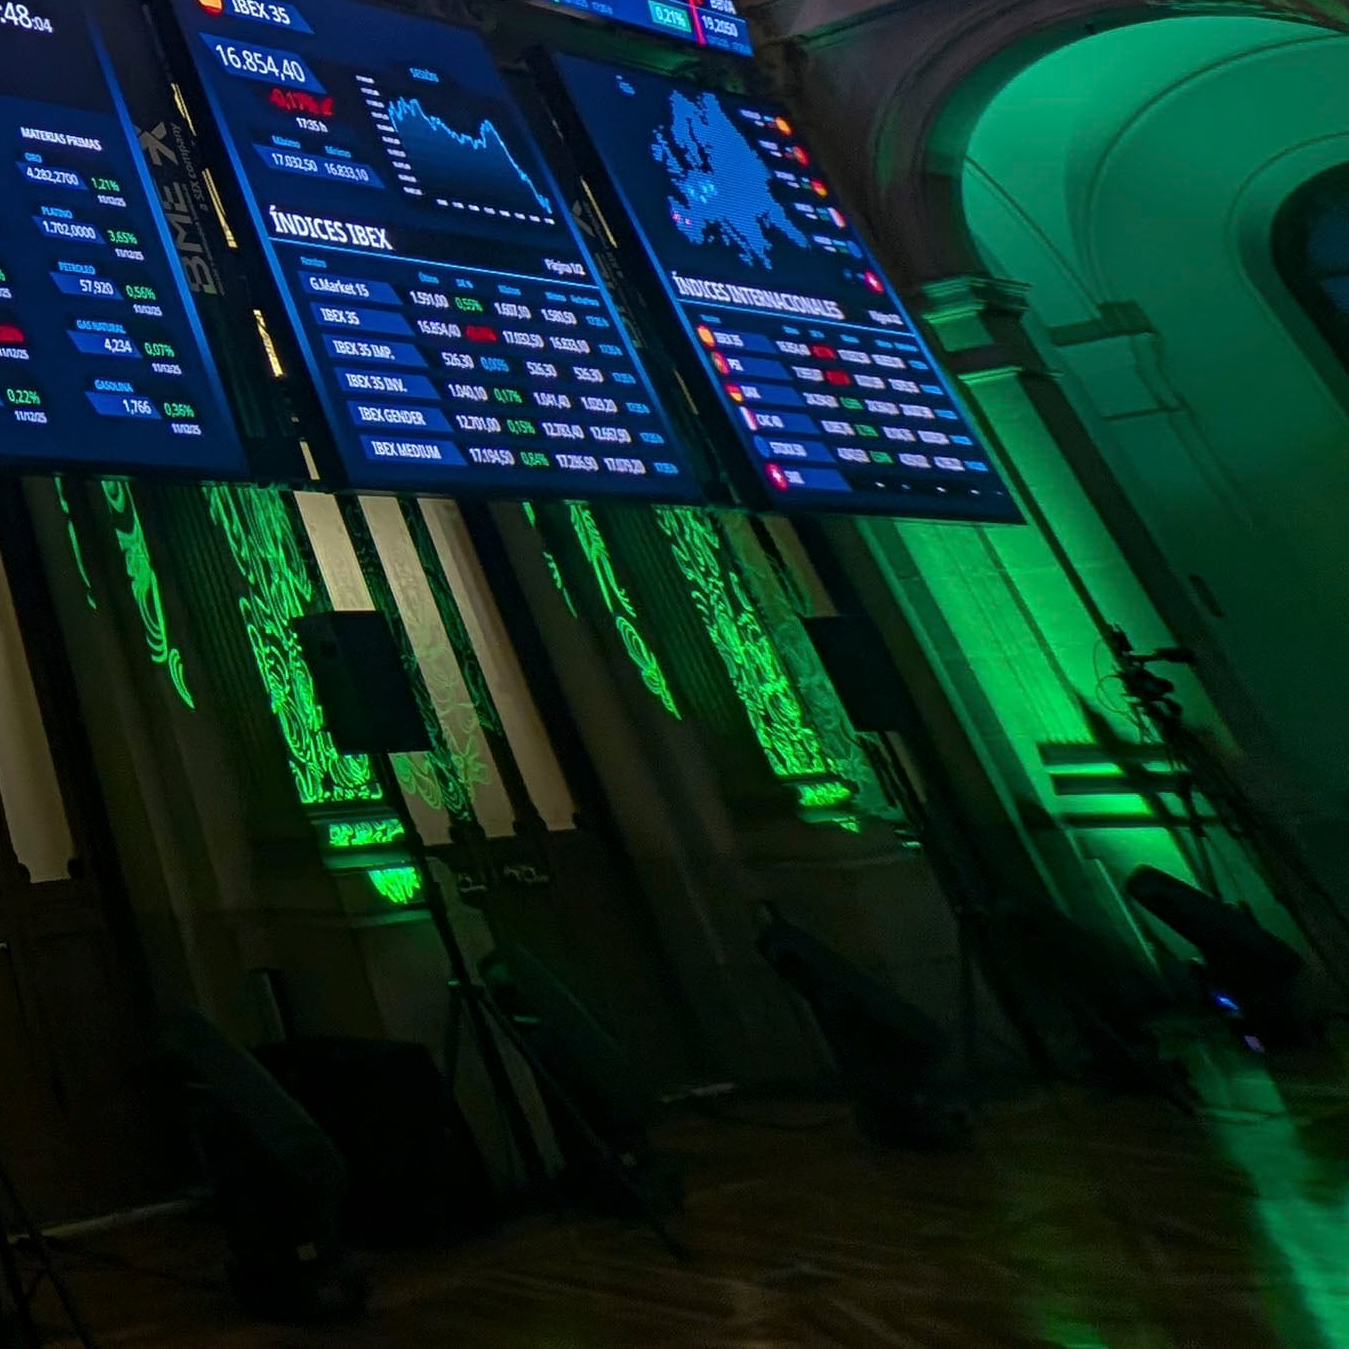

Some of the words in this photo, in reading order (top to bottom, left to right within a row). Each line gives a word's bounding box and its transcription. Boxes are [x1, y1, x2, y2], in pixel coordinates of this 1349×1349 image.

[269, 5, 290, 24] 35
[655, 6, 686, 27] 0,21%
[216, 45, 305, 82] 16.854,40
[270, 205, 347, 242] ÍNDICES
[346, 223, 393, 250] IBEX
[320, 308, 343, 324] IBEX
[358, 407, 383, 422] IBEX
[371, 441, 397, 456] IBEX
